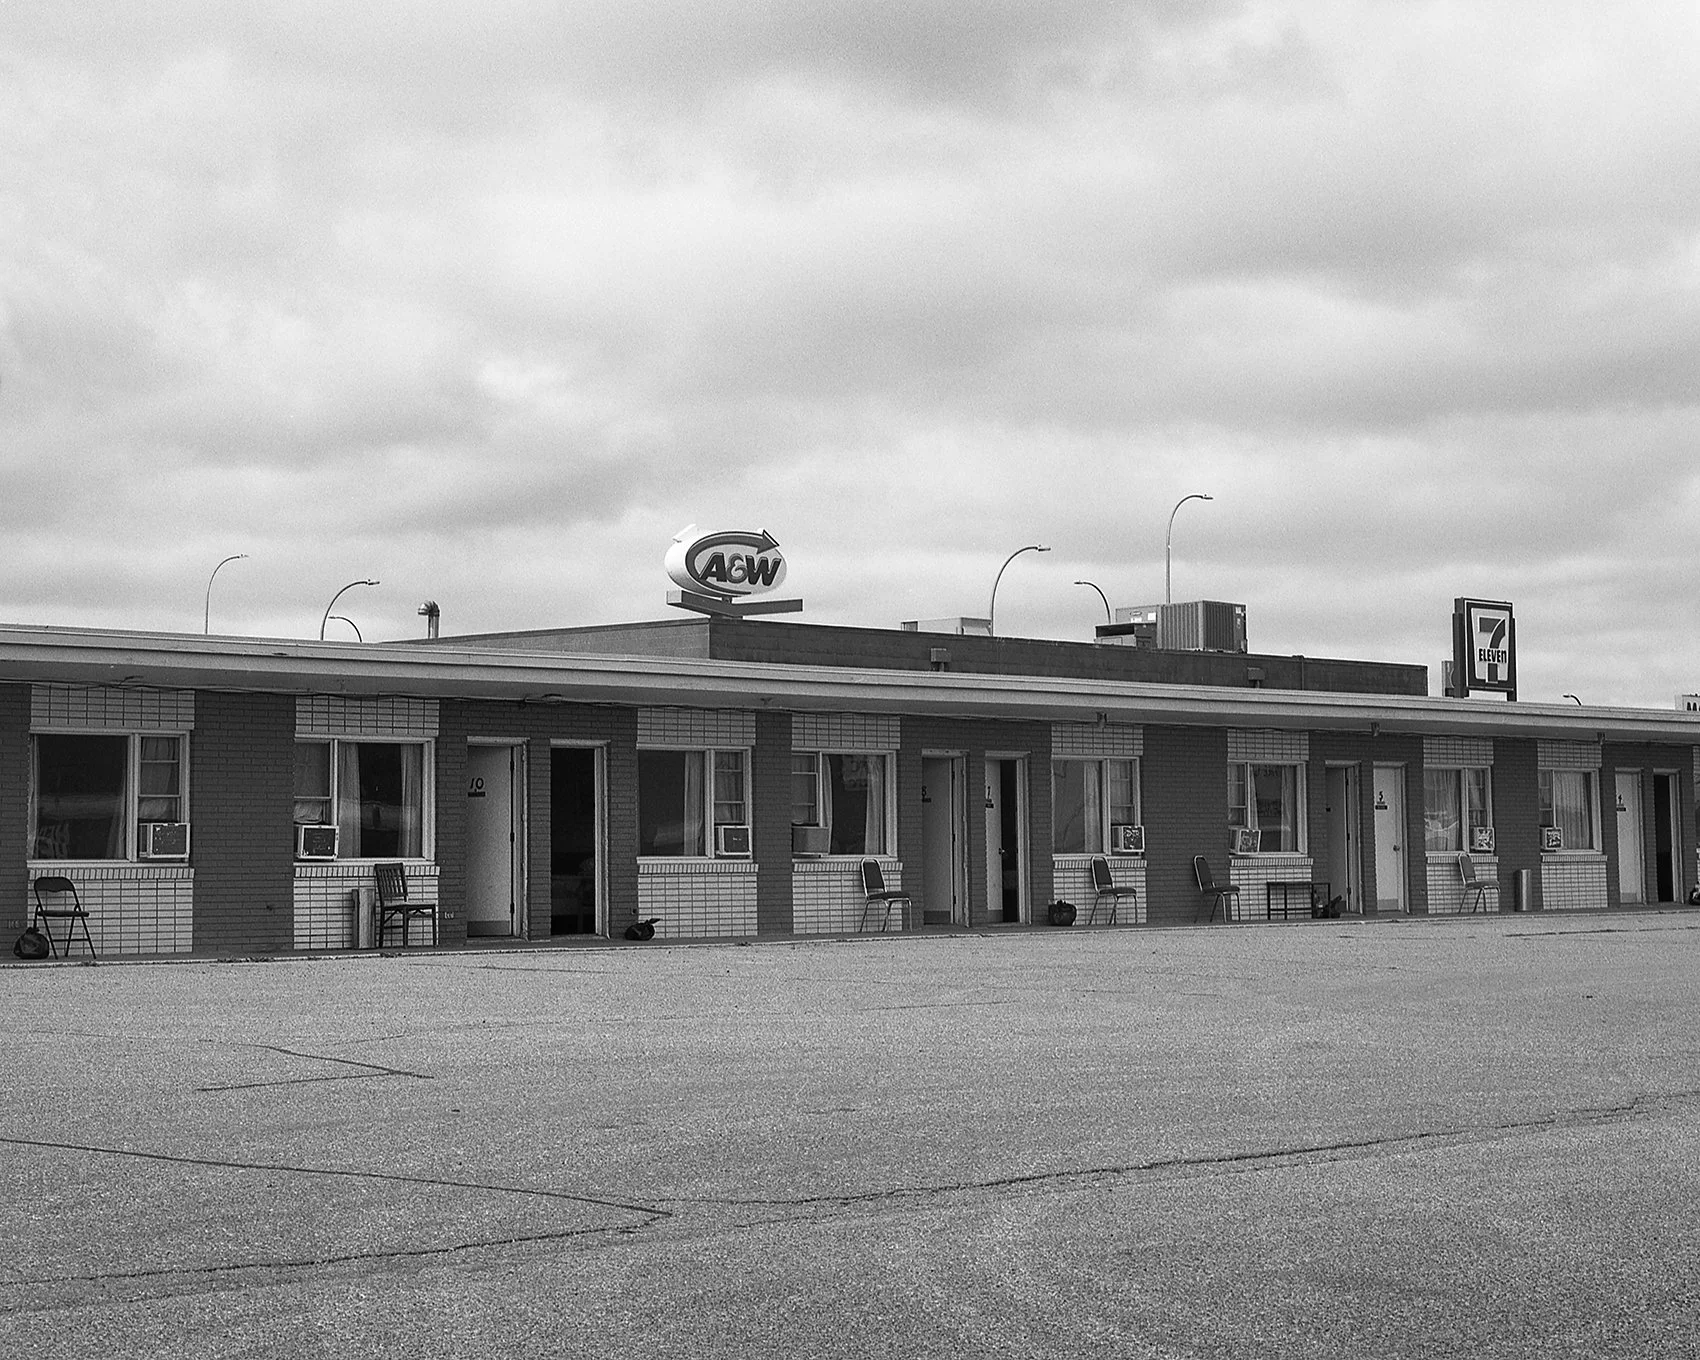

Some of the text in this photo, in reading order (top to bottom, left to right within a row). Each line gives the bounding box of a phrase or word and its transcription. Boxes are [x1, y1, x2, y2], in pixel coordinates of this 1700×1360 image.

[699, 552, 782, 587] A&W
[1479, 616, 1506, 682] 7
[470, 777, 484, 790] 10
